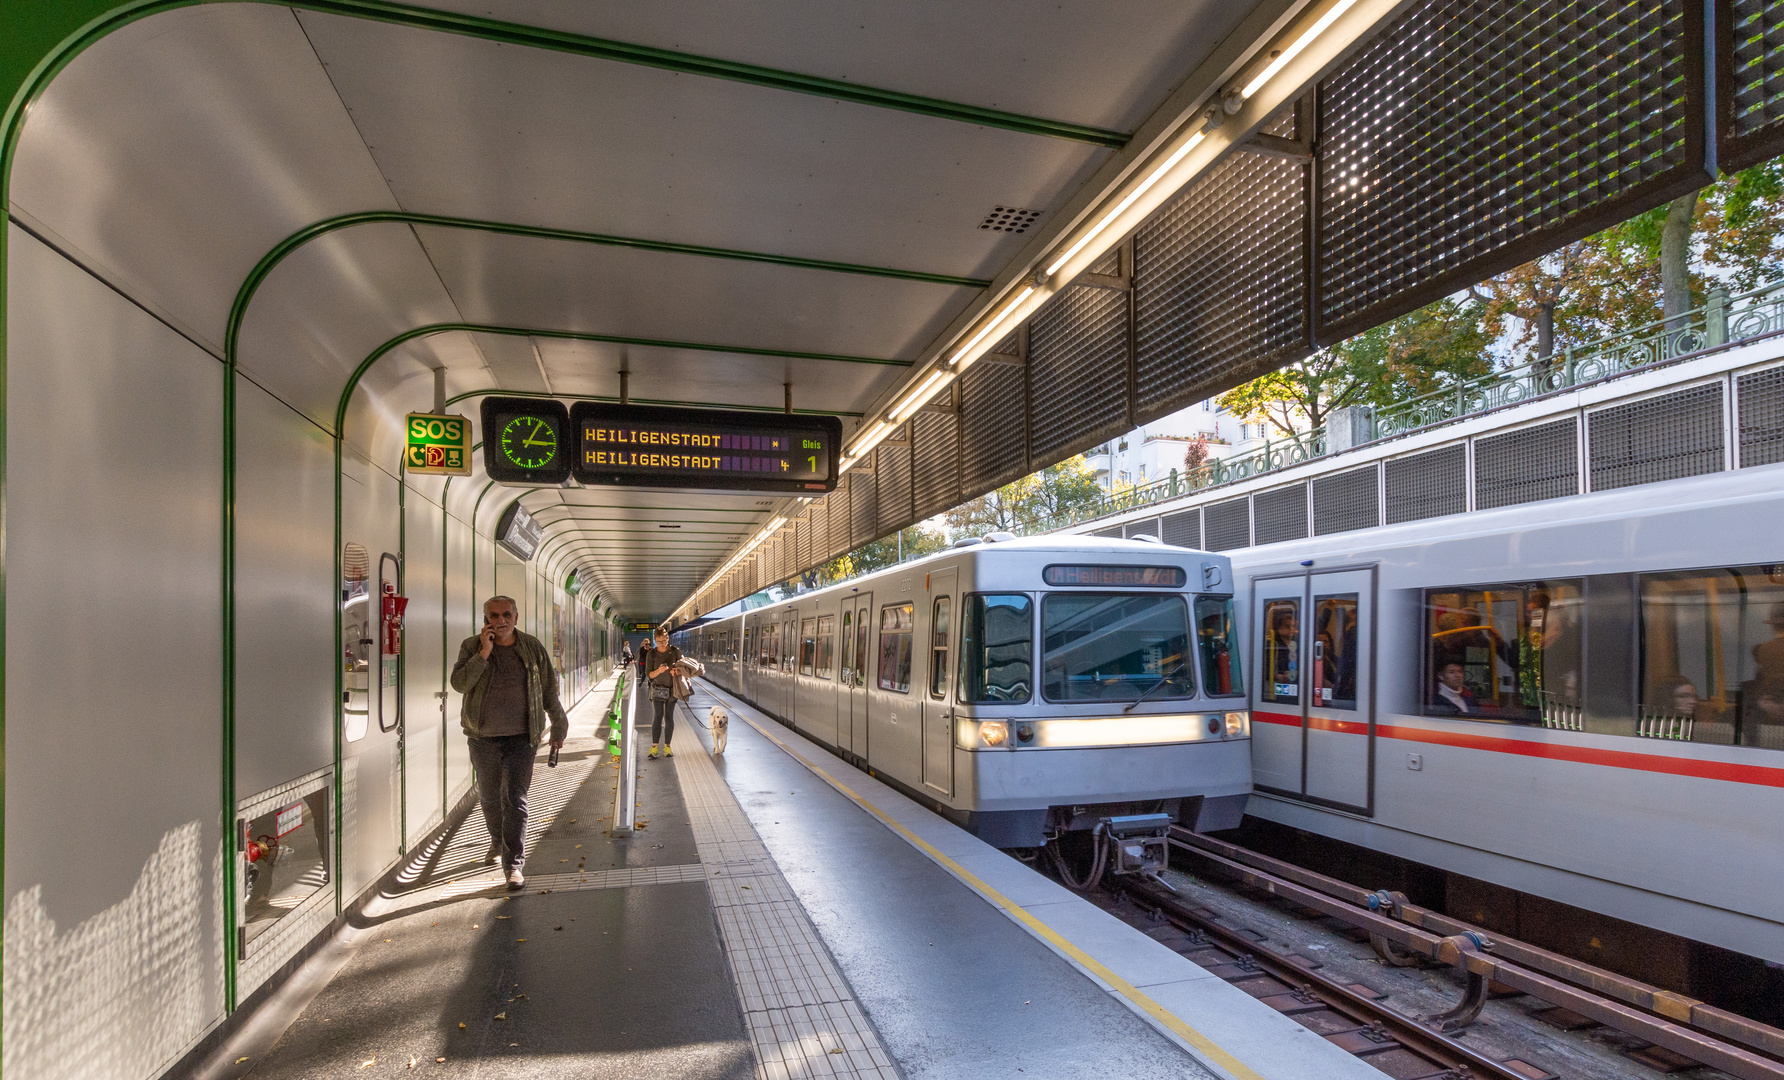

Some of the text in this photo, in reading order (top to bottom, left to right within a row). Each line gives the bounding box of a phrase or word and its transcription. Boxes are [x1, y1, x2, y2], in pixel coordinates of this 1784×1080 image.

[411, 419, 461, 440] SOS
[585, 428, 721, 447] HEILIGENSTADT
[803, 439, 821, 449] Gleis
[585, 451, 790, 471] HEILIGENSTADT 4
[807, 455, 816, 472] 1
